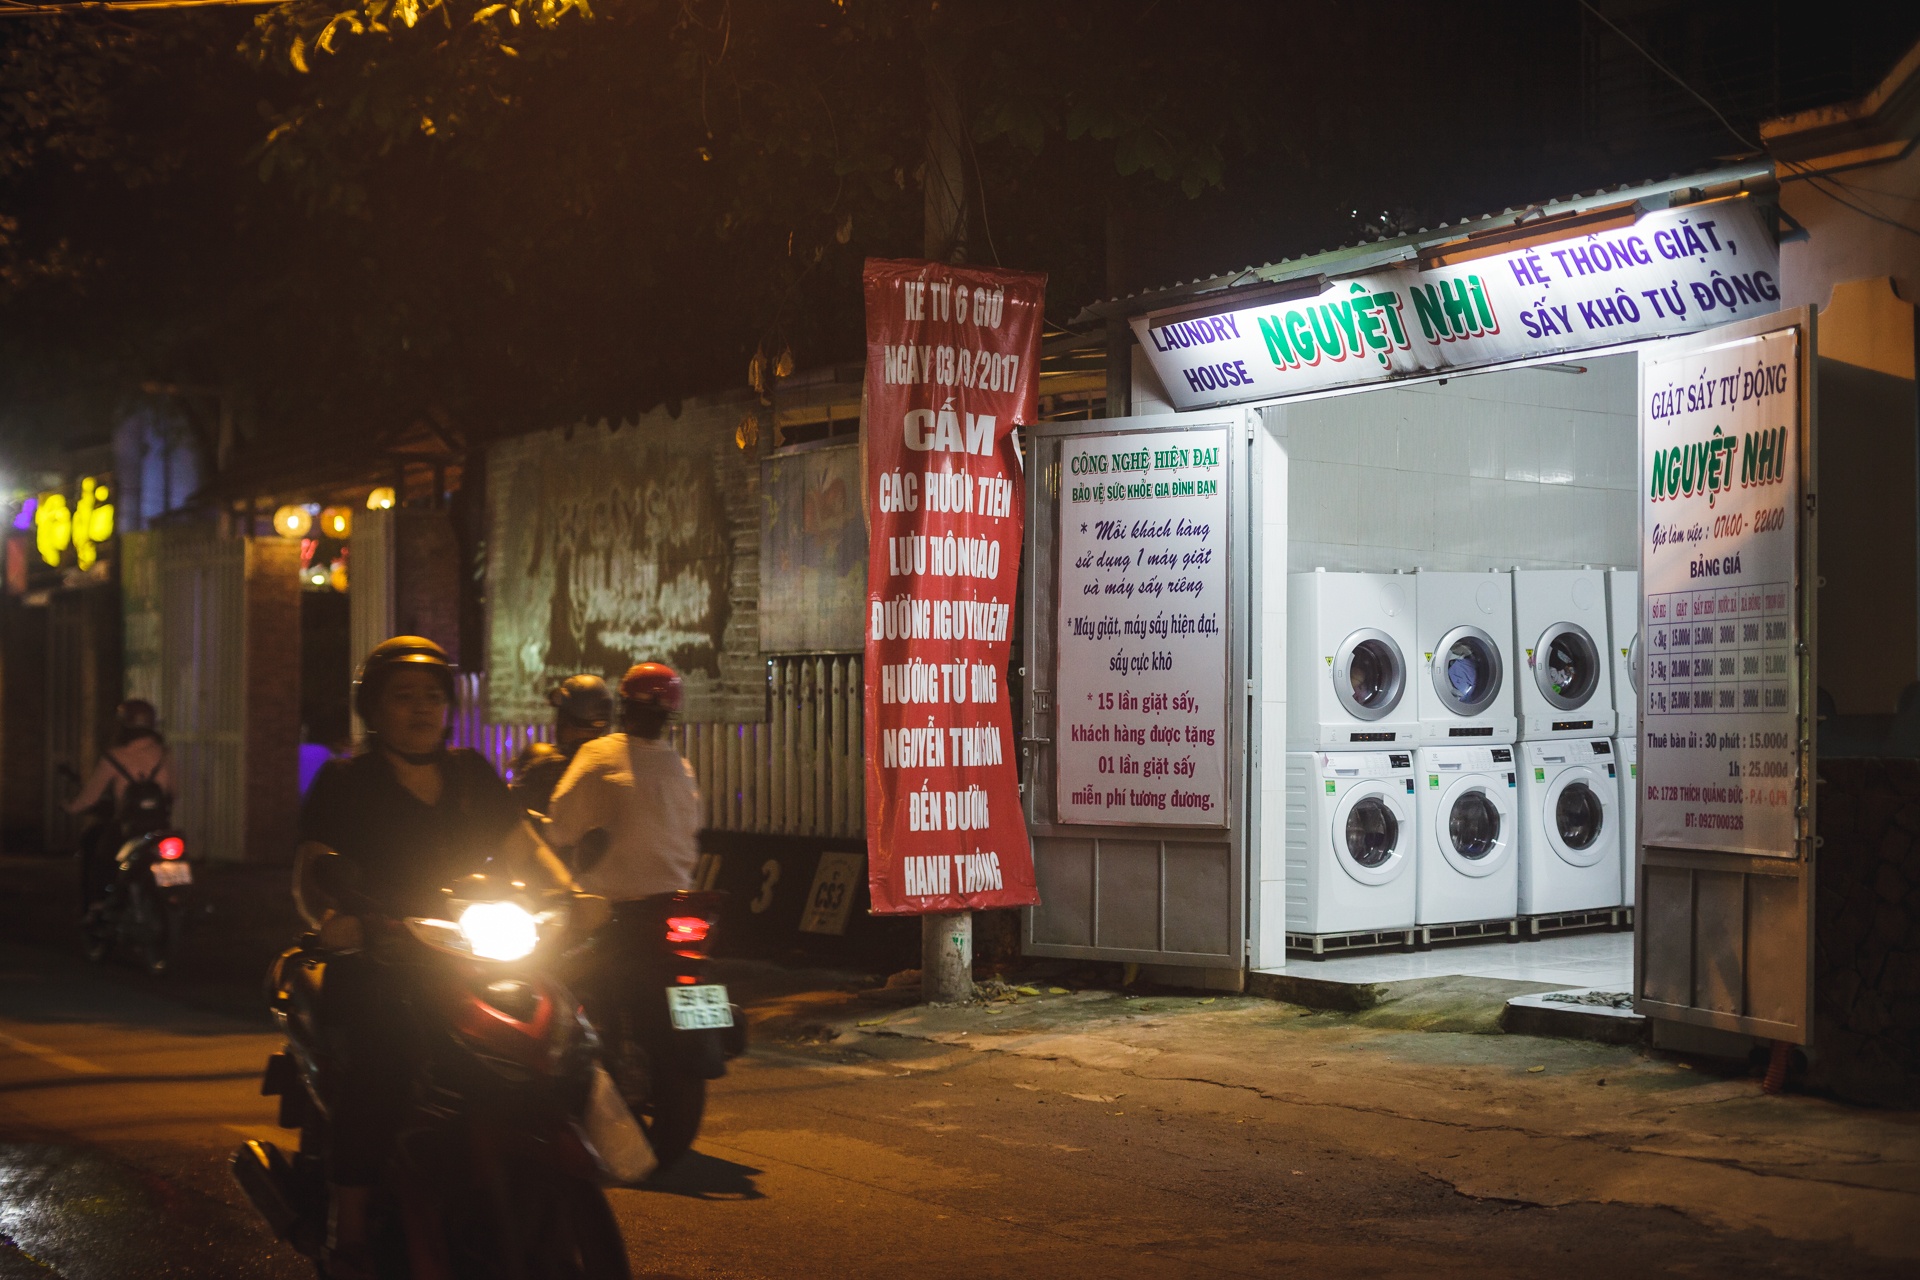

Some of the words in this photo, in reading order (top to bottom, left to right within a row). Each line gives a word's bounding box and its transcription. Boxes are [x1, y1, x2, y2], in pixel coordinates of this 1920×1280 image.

[1507, 248, 1552, 290] HỆ
[1552, 232, 1653, 280] THỐNG
[1654, 218, 1736, 263] GIẶT,
[930, 277, 952, 323] TỪ
[955, 284, 968, 324] 6
[973, 283, 1004, 329] GIỜ
[1519, 296, 1573, 340] SẤY
[1577, 287, 1641, 330] KHÔ
[1642, 279, 1687, 322] TỰ
[1691, 270, 1780, 314] ĐỘNG
[1149, 313, 1241, 353] LAUNDRY
[1257, 282, 1410, 370] NGUYỆT
[884, 339, 931, 385] NGÀY
[936, 345, 1019, 393] 03/9/2017
[1183, 359, 1255, 393] HOUSE
[1651, 382, 1685, 426] GIẶT
[1687, 366, 1717, 413] SẤY
[1719, 366, 1741, 412] TỰ
[1743, 360, 1788, 406] ĐỘNG
[1071, 451, 1108, 475] CÔNG
[1111, 447, 1150, 475] NGHỆ
[1154, 445, 1190, 473] HIỆN
[1192, 447, 1220, 472] ĐẠI
[1650, 424, 1738, 508] NGUYỆT
[1741, 425, 1788, 488] NHI
[879, 467, 918, 513] CÁC
[978, 471, 1013, 525] TIỆN
[1072, 482, 1090, 502] BẢO
[1092, 483, 1104, 504] VỆ
[1107, 482, 1125, 500] SỨC
[1155, 482, 1170, 497] GIA
[1172, 479, 1195, 496] ĐÌNH
[1197, 479, 1217, 499] BẠN
[1094, 519, 1127, 541] Mỗi
[1130, 518, 1172, 539] khách
[1176, 517, 1211, 542] hàng
[1652, 523, 1667, 553] Giờ
[1668, 523, 1685, 544] làm
[1686, 522, 1703, 547] việc
[889, 530, 926, 576] LƯU
[1075, 550, 1095, 569] sử
[1096, 550, 1132, 573] dụng
[1136, 547, 1146, 567] 1
[1147, 548, 1178, 571] máy
[1182, 547, 1212, 571] giặt
[1690, 553, 1720, 578] BẢNG
[1722, 551, 1741, 574] GIÁ
[1083, 578, 1100, 596] và
[1104, 576, 1135, 599] máy
[1138, 575, 1164, 598] sấy
[1167, 576, 1204, 598] riêng
[871, 593, 931, 641] ĐƯỜNG
[1073, 613, 1095, 640] Máy
[1097, 615, 1122, 641] giặt,
[1124, 613, 1148, 640] máy
[1149, 610, 1169, 639] sấy
[1170, 613, 1195, 639] hiện
[1197, 612, 1219, 639] đại,
[1109, 648, 1129, 676] sấy
[1130, 652, 1149, 676] cực
[1151, 651, 1173, 671] khô
[882, 656, 939, 704] HƯỚNG
[941, 657, 968, 704] TỪ
[1098, 692, 1114, 710] 15
[1118, 690, 1138, 711] lần
[1142, 692, 1168, 715] giặt
[1172, 690, 1199, 714] sấy,
[883, 716, 945, 769] NGUYỄN
[1071, 724, 1110, 742] khách
[1114, 724, 1146, 745] hàng
[1150, 725, 1181, 746] được
[1185, 725, 1216, 748] tặng
[1647, 733, 1668, 749] Thuê
[1670, 733, 1686, 748] bàn
[1688, 731, 1697, 748] ủi
[1705, 733, 1717, 748] 30
[1719, 733, 1740, 751] phút
[1749, 733, 1788, 749] 15.000đ
[1098, 756, 1115, 774] 01
[1119, 753, 1139, 774] lần
[1143, 757, 1169, 780] giặt
[1173, 755, 1196, 778] sấy
[1729, 761, 1740, 777] 1h
[1749, 761, 1788, 777] 25.000đ
[909, 778, 942, 832] ĐẾN
[945, 784, 990, 831] ĐƯỜNG
[1071, 784, 1102, 805] miễn
[1106, 788, 1126, 808] phí
[1130, 789, 1167, 810] tương
[1170, 790, 1215, 811] đương.
[1680, 784, 1701, 802] THÍCH
[1702, 783, 1727, 804] QUẢNG
[904, 855, 951, 904] HẠNH
[954, 846, 1003, 894] THÔNG
